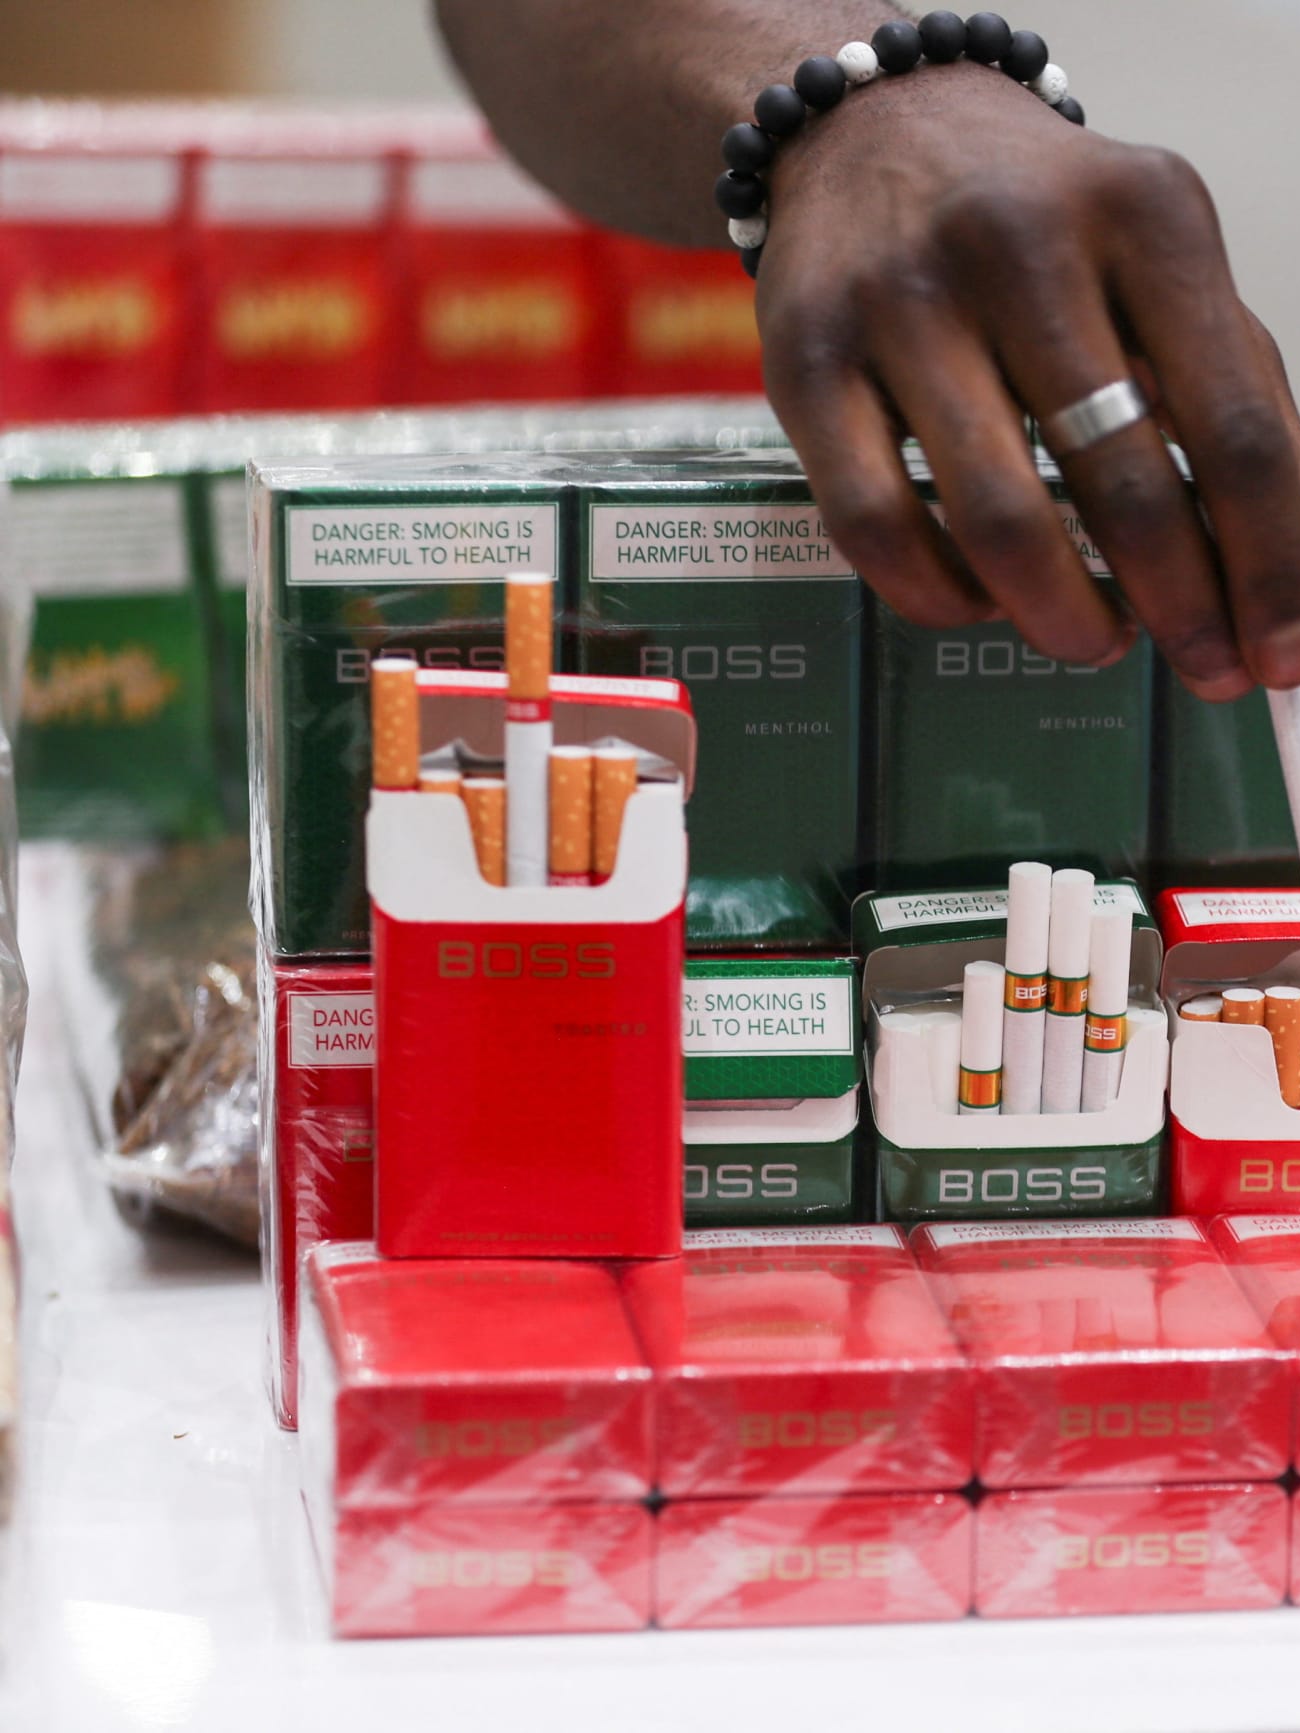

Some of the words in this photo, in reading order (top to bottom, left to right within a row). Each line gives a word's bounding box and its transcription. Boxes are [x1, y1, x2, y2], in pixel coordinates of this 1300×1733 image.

[312, 523, 405, 541] DANGER:
[412, 521, 509, 540] SMOKING
[517, 520, 533, 538] IS
[616, 521, 707, 539] DANGER:
[713, 520, 809, 538] SMOKING
[315, 547, 412, 566] HARMFUL
[419, 546, 447, 564] TO
[454, 546, 531, 564] HEALTH
[618, 546, 714, 563] HARMFUL
[720, 545, 748, 563] TO
[755, 544, 830, 562] HEALTH
[640, 644, 806, 680] BOSS
[937, 641, 1099, 675] BOS
[745, 722, 832, 735] MENTHOL
[1040, 716, 1126, 729] MENTHOL
[898, 896, 989, 909] DANGER:
[904, 905, 999, 919] HARMFUL
[439, 941, 616, 979] BOSS
[1015, 984, 1047, 999] BOS
[704, 993, 803, 1012] SMOKING
[810, 992, 826, 1010] IS
[313, 1009, 374, 1026] DANG
[712, 1018, 740, 1037] TO
[748, 1018, 825, 1036] HEALTH
[316, 1034, 374, 1050] HARM
[1086, 1024, 1116, 1041] SS
[683, 1163, 798, 1199] OSS
[939, 1167, 1106, 1202] BOSS
[738, 1409, 897, 1448] BOSS
[1057, 1402, 1215, 1439] BOSS
[1055, 1531, 1210, 1568] BOSS
[735, 1545, 892, 1582] BOSS
